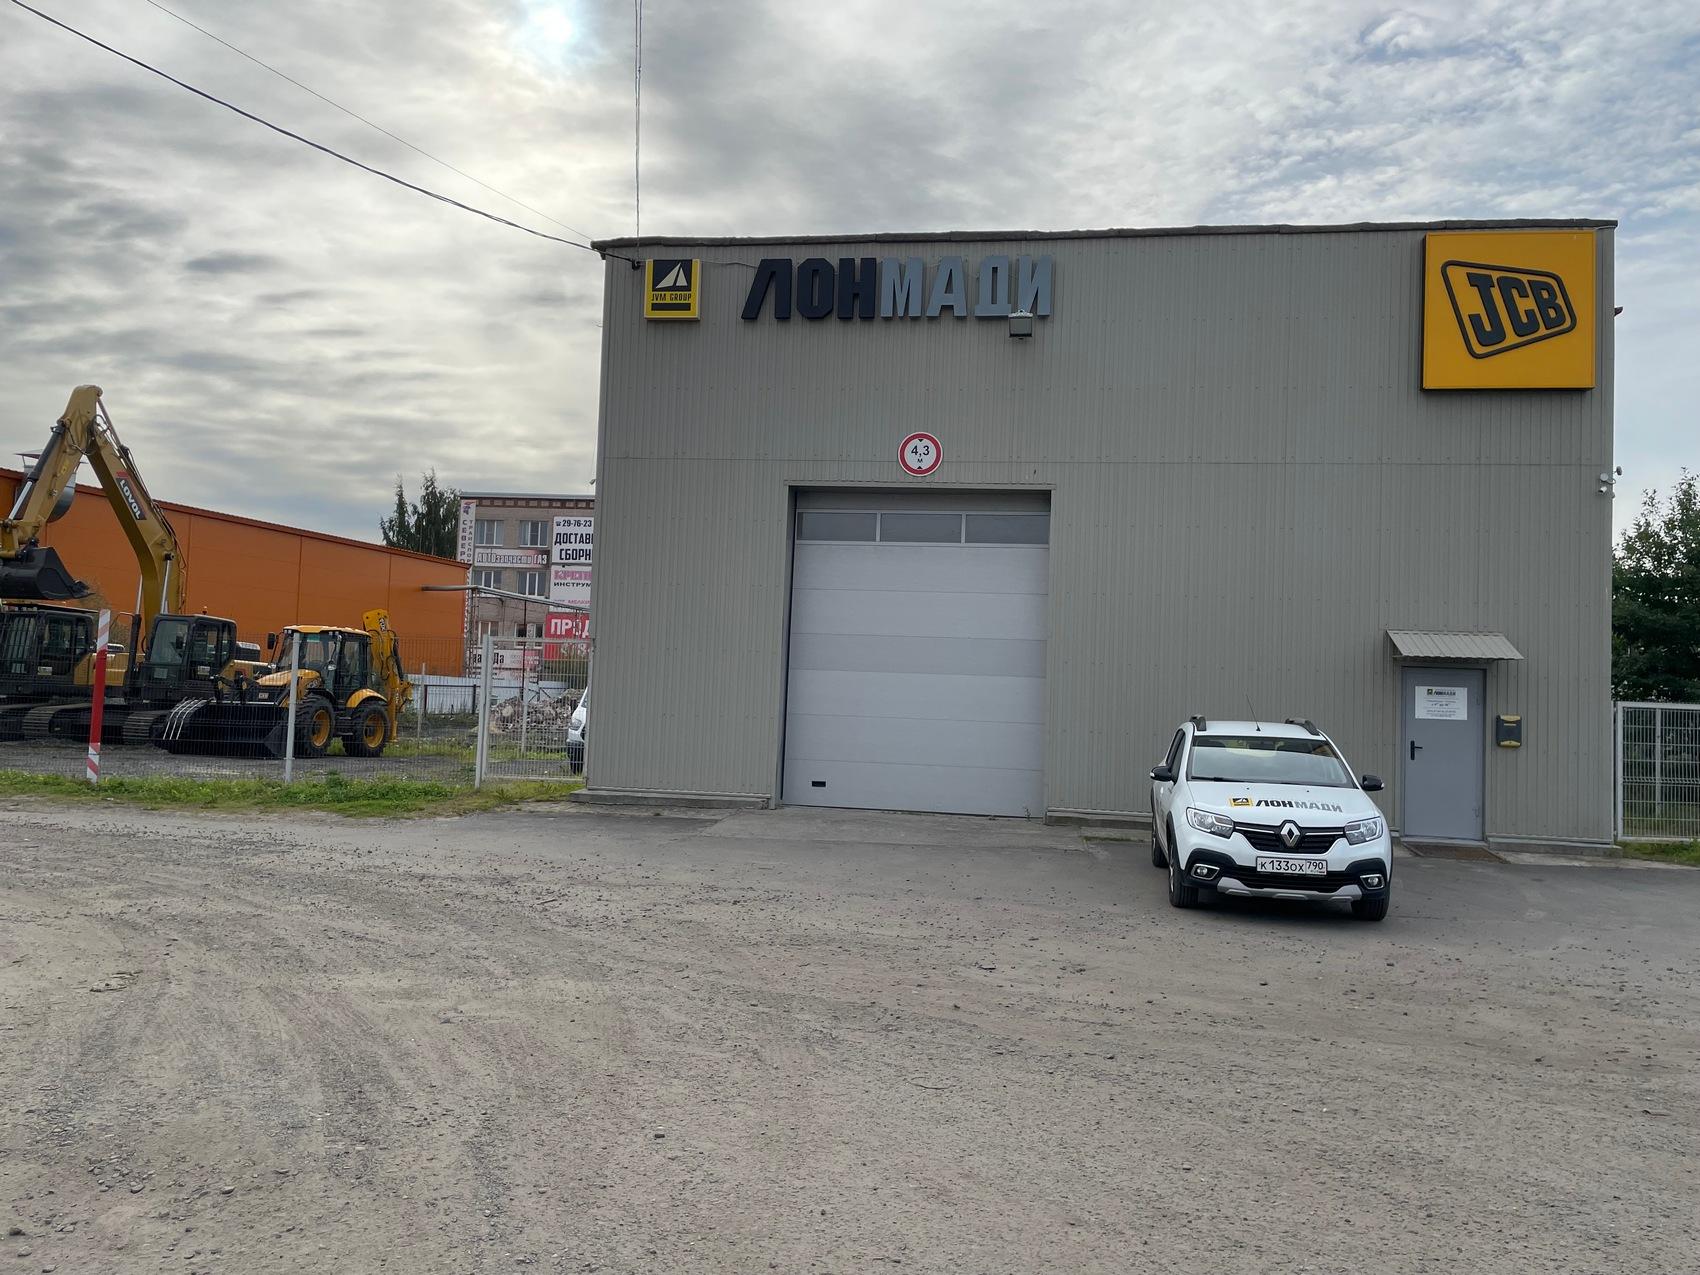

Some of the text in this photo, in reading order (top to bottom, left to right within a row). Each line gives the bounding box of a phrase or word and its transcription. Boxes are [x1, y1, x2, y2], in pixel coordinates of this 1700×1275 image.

[741, 255, 1051, 319] ЛОНМАДИ
[651, 293, 691, 301] JVM GROUP
[1466, 272, 1566, 347] JCB
[911, 445, 930, 457] 4,3
[120, 479, 141, 520] LOVOL
[560, 548, 591, 560] СБОРН
[1256, 799, 1343, 812] ЛОНМАДИ
[1307, 861, 1324, 870] 790
